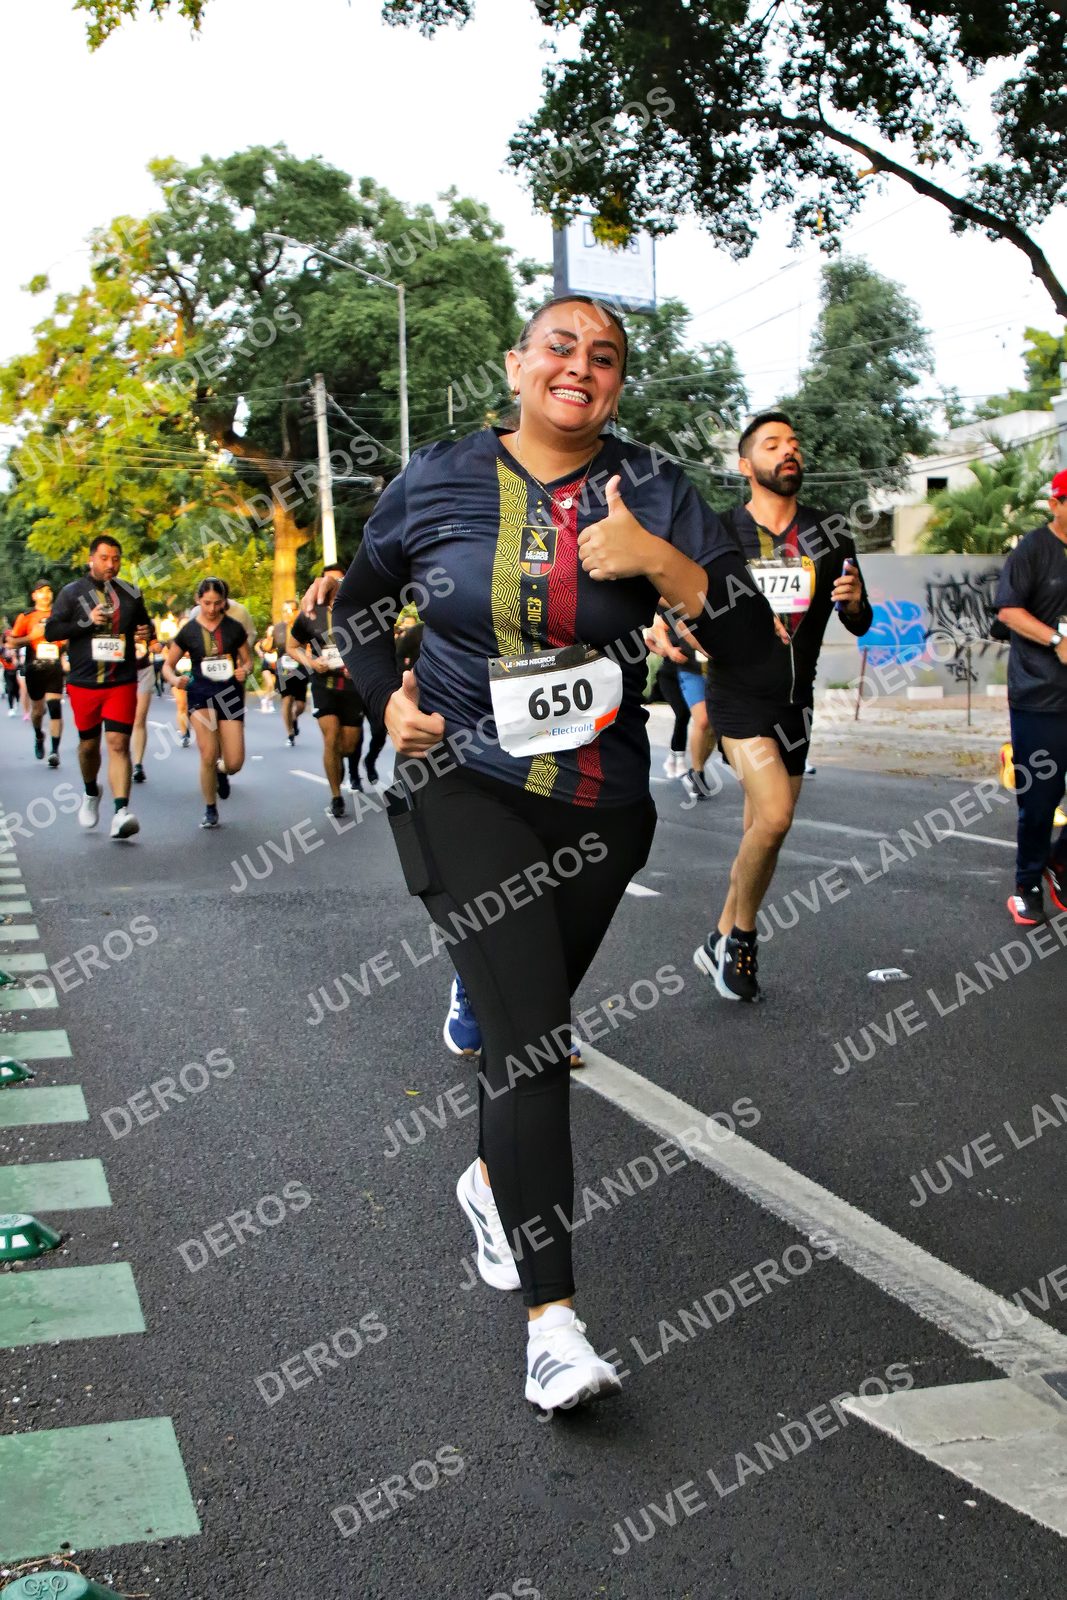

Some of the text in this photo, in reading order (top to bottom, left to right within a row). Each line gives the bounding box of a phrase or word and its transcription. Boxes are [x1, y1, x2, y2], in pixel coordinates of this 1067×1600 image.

[758, 575, 800, 593] 1774
[528, 678, 593, 720] 650
[552, 723, 594, 736] Electrolit
